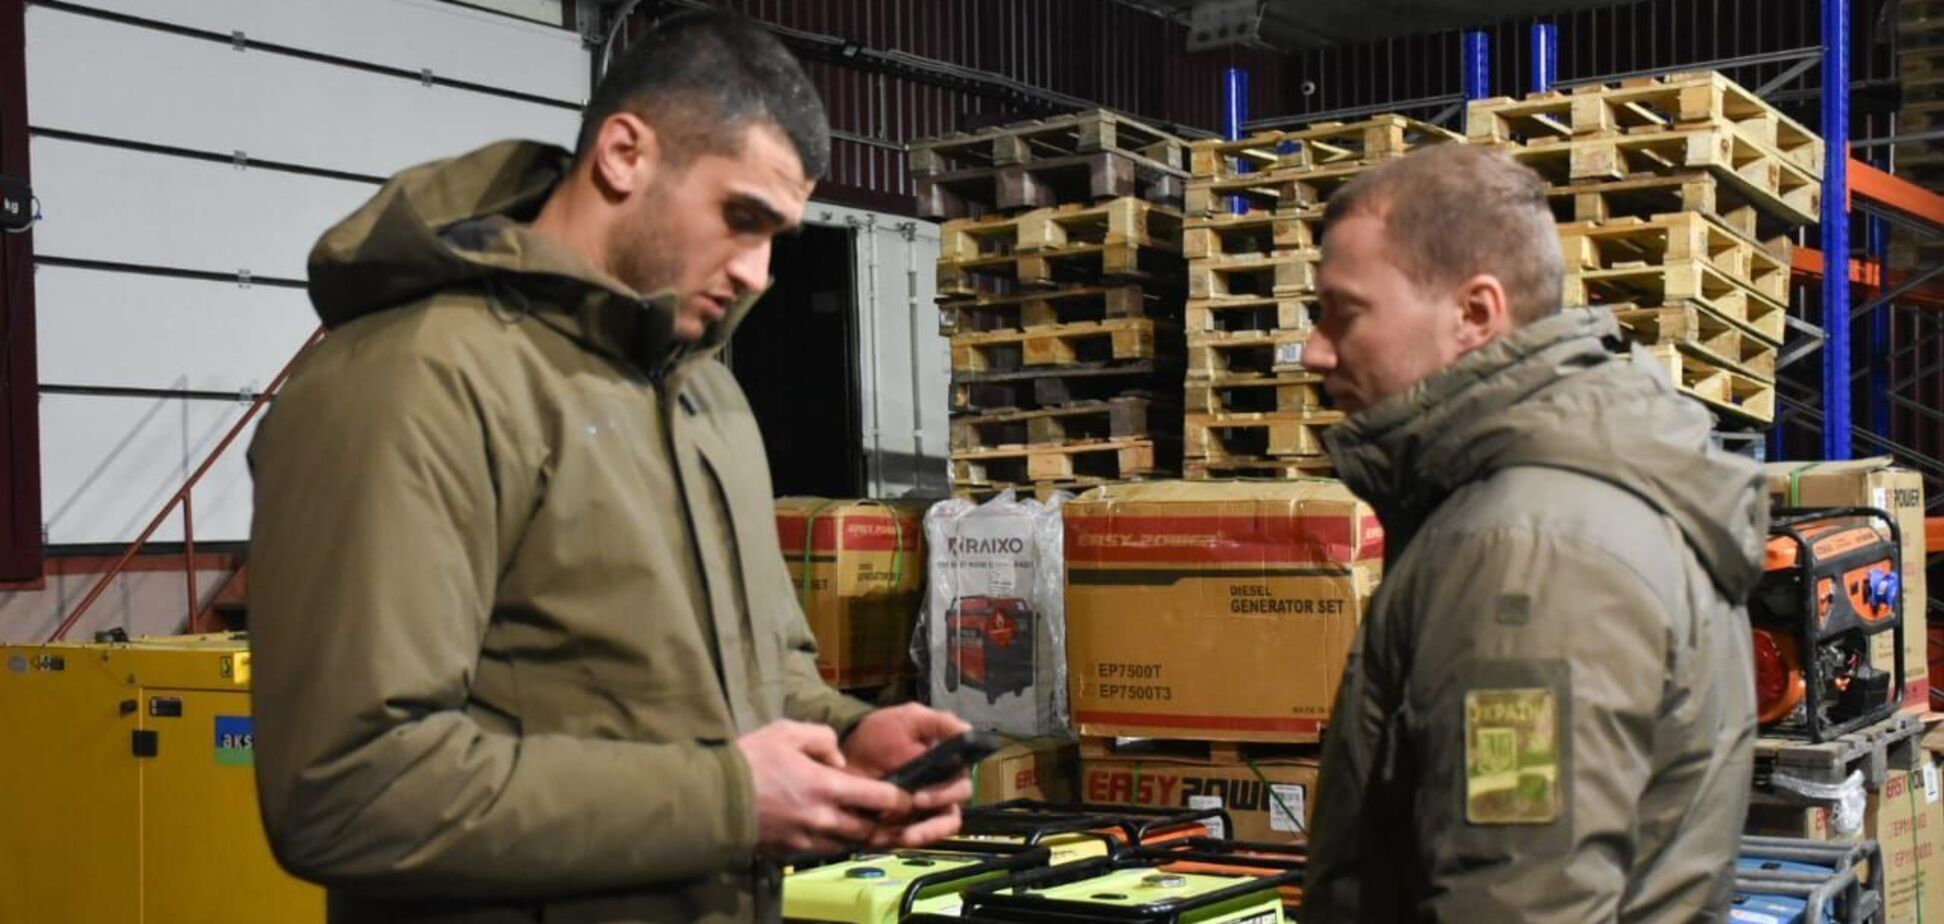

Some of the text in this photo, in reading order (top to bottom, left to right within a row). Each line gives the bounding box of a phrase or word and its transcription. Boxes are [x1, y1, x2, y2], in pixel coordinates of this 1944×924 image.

[1229, 585, 1272, 597] DIESEL
[1230, 598, 1345, 614] GENERATOR SET
[1098, 663, 1162, 679] EP7500T
[1099, 683, 1172, 701] EP7500T3
